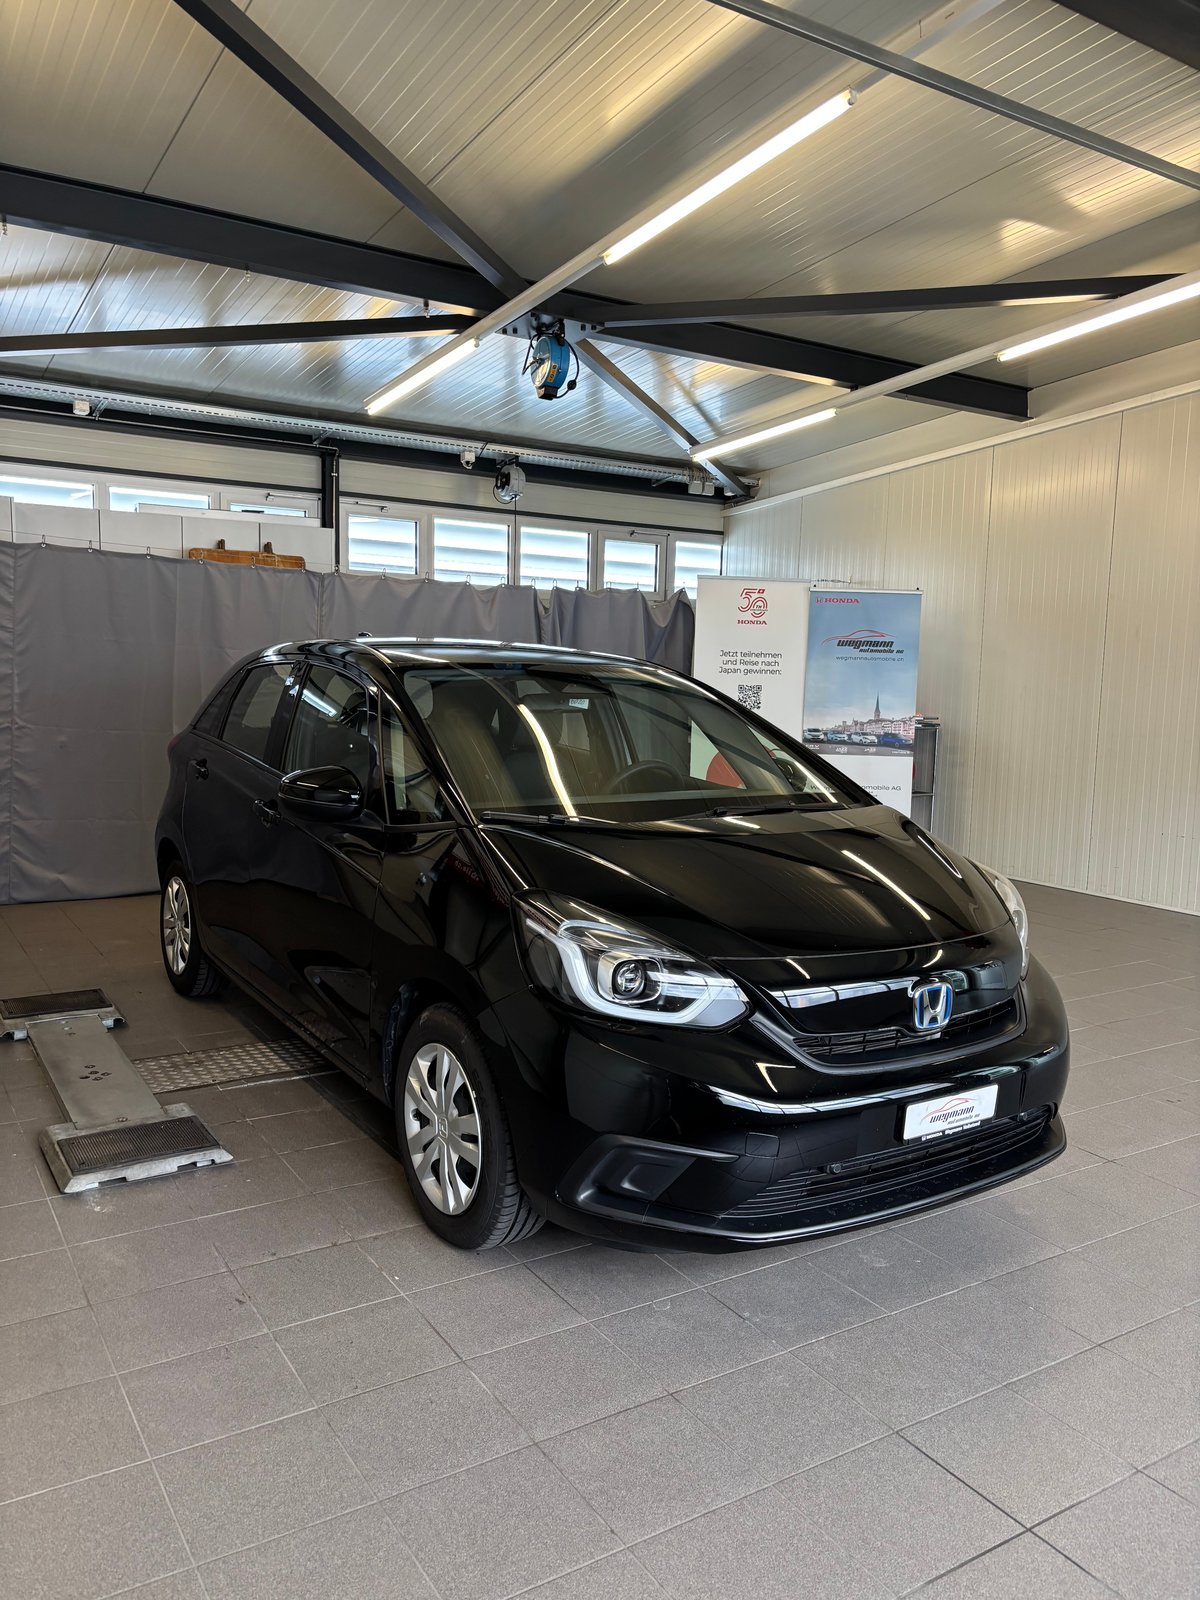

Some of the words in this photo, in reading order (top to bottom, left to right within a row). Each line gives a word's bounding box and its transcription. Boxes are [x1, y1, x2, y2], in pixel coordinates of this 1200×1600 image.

[836, 639, 894, 649] wegmann
[740, 651, 782, 659] teilnehmen
[743, 667, 782, 676] gewinnen:
[930, 1106, 975, 1124] wegmann
